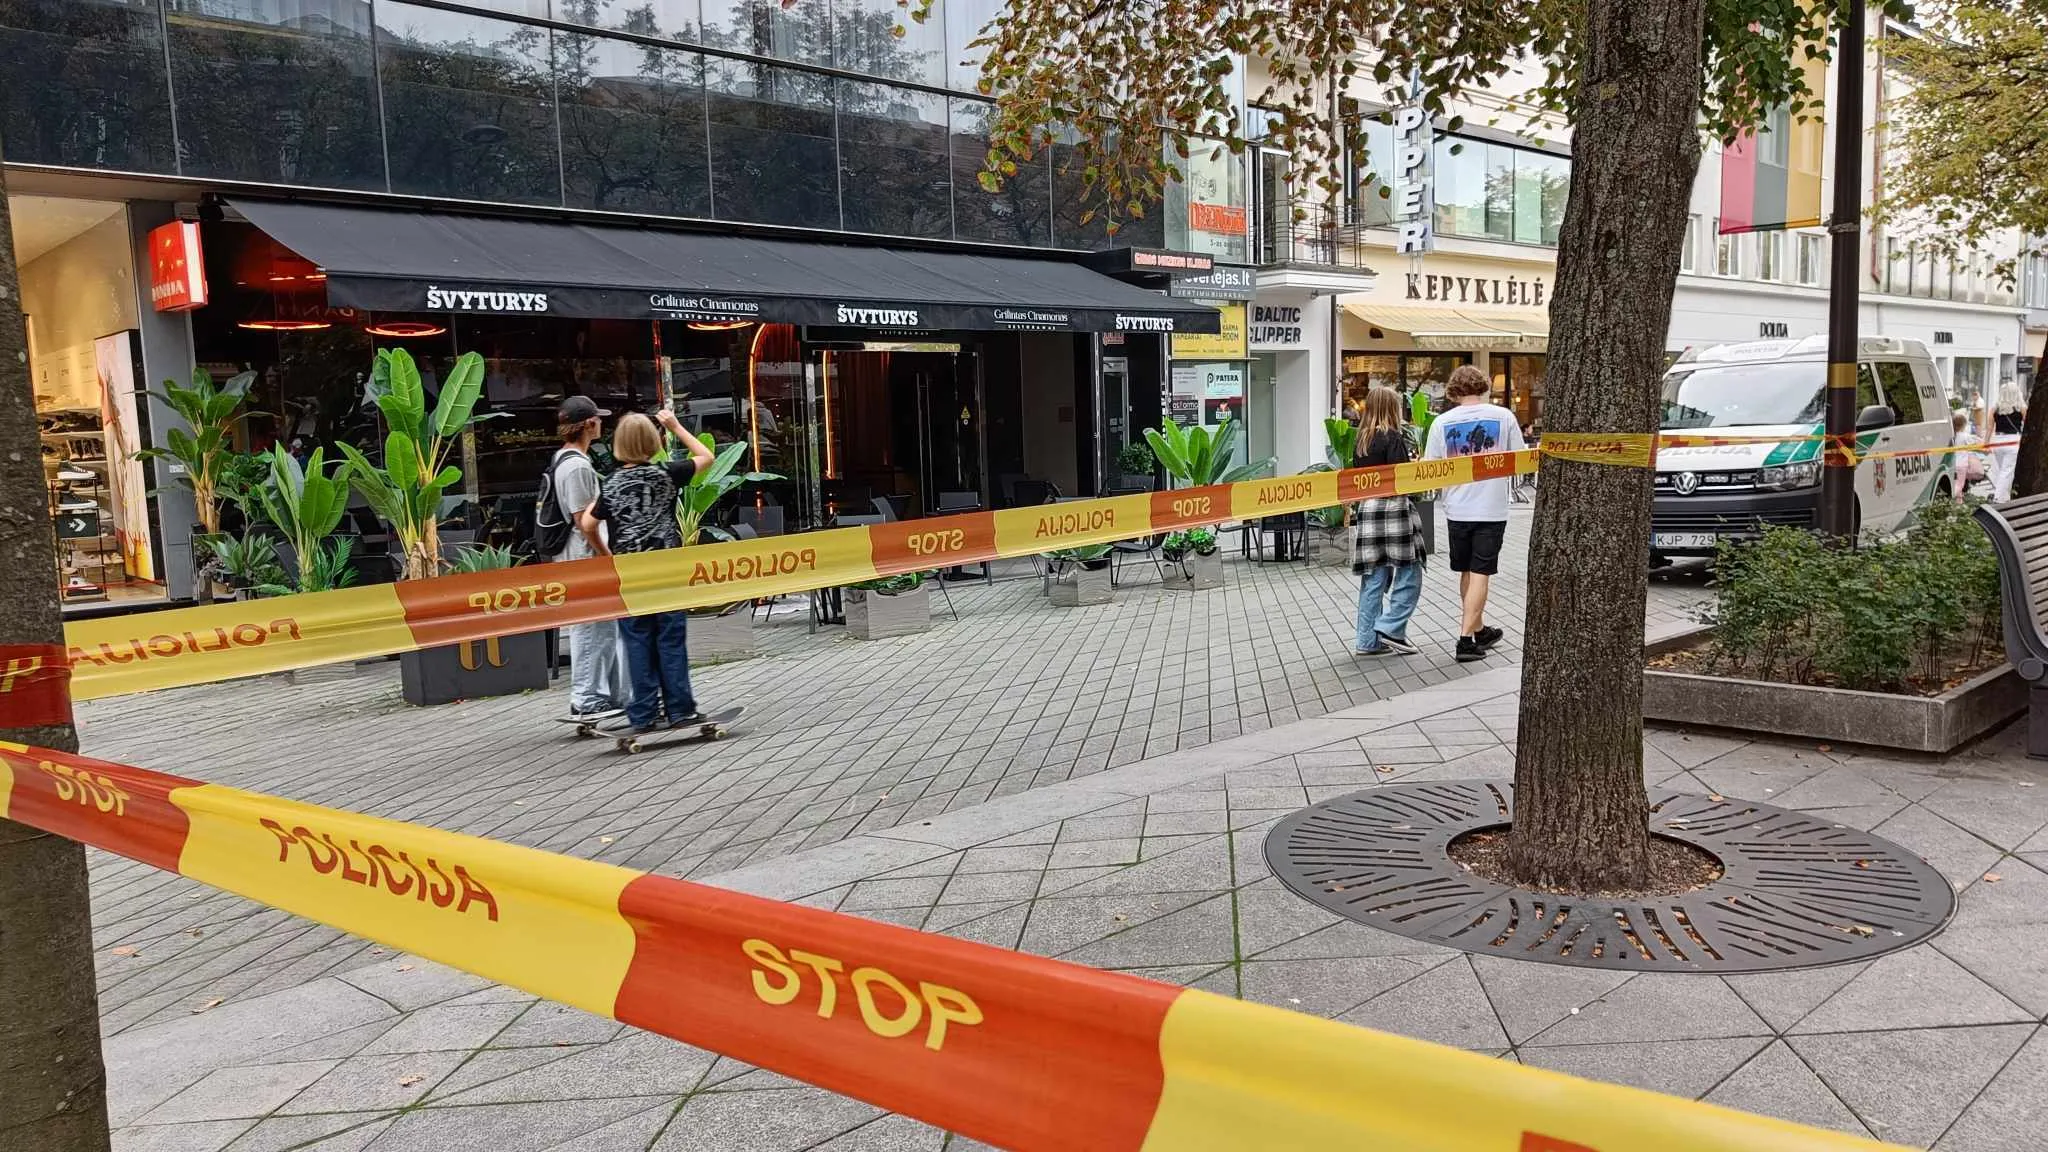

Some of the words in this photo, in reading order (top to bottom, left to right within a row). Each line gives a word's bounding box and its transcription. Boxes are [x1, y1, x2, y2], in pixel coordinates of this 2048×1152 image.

[427, 286, 548, 312] ŠVYTURYS
[837, 303, 918, 326] ŠVYTURYS
[1115, 313, 1174, 332] ŠVYTURYS
[1254, 306, 1301, 323] BALTIC
[1546, 438, 1623, 456] POLICIJA
[1895, 455, 1932, 477] POLICIJA
[1656, 534, 1683, 546] KJP
[1690, 534, 1716, 546] 729
[39, 760, 130, 817] STOP
[258, 818, 500, 922] POLICIJA
[740, 937, 985, 1051] STOP
